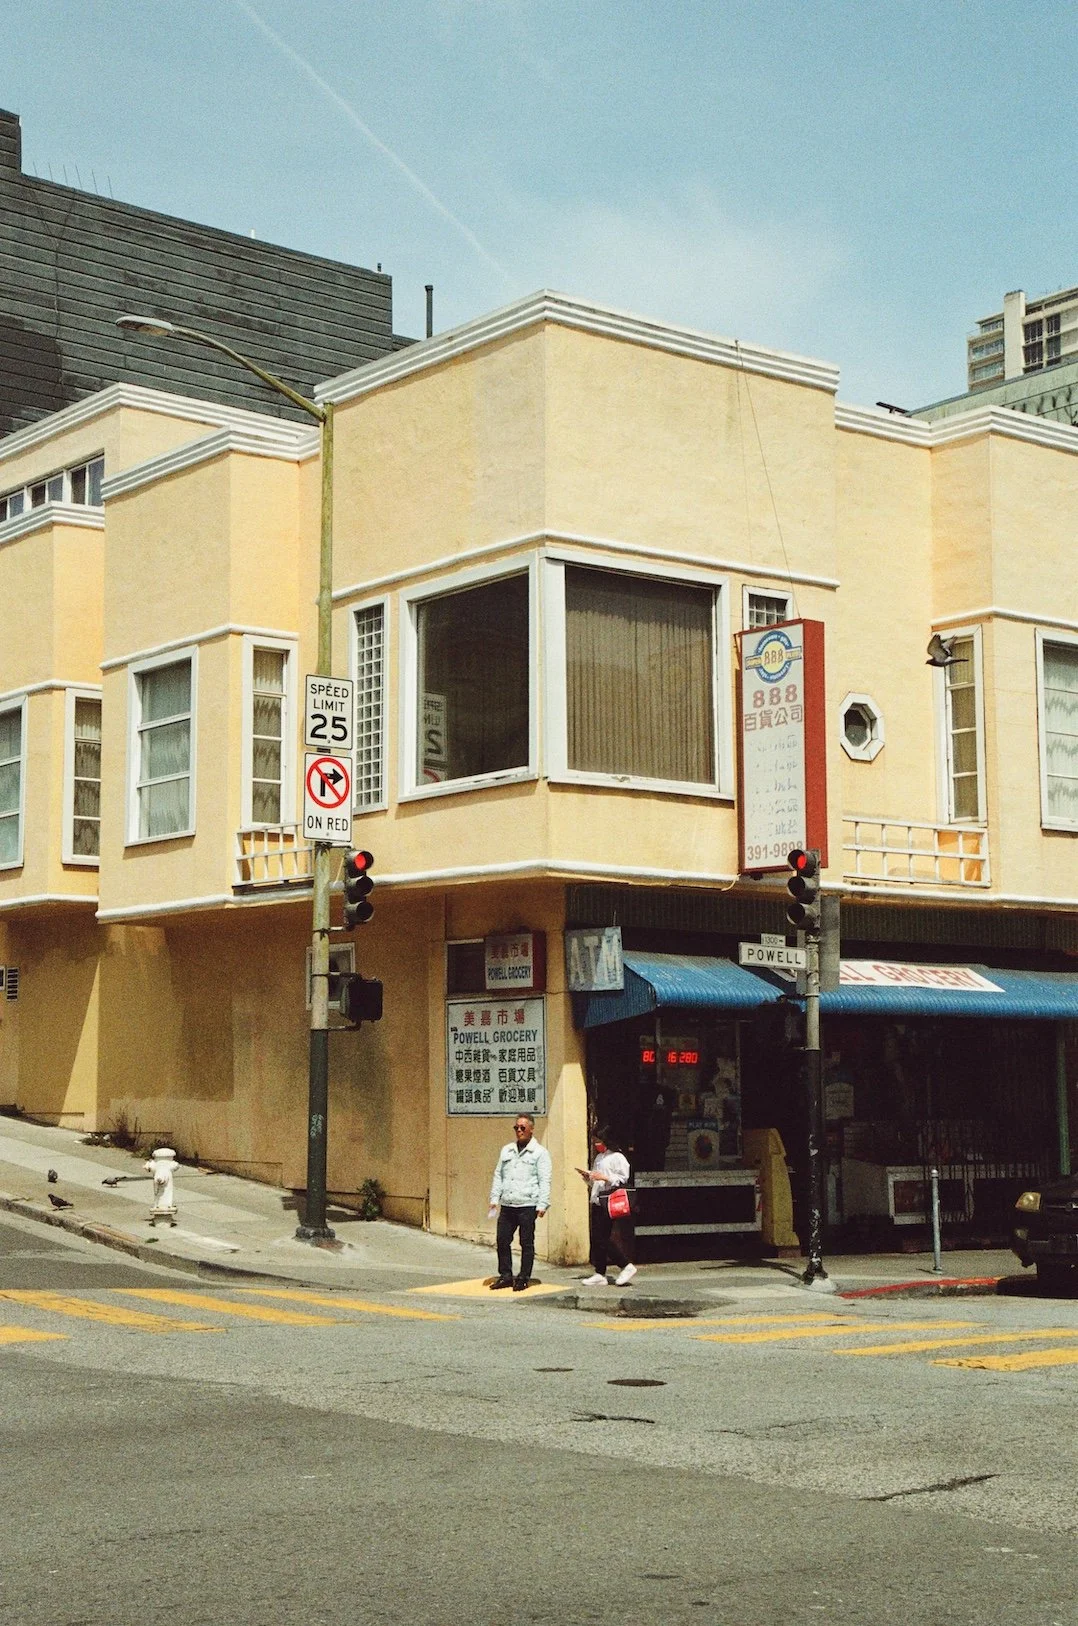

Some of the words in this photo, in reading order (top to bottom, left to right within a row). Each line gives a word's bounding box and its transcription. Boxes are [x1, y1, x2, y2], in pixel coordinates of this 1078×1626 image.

[310, 683, 349, 699] SPEED
[753, 684, 798, 709] 888
[313, 698, 345, 712] LIMIT
[744, 704, 803, 732] 百貨公司
[310, 713, 348, 742] 25
[307, 815, 323, 829] ON
[327, 817, 348, 832] RED
[570, 934, 620, 984] ATM
[747, 949, 802, 965] POWELL
[488, 967, 507, 980] POWELL
[508, 965, 531, 979] GROCERY
[872, 964, 985, 988] GROCERY
[464, 1008, 526, 1027] 美嘉市場
[453, 1032, 489, 1044] POWELL
[493, 1029, 538, 1043] GROCERY
[499, 1047, 536, 1062] 家庭用品
[498, 1067, 536, 1083] 百貨文具
